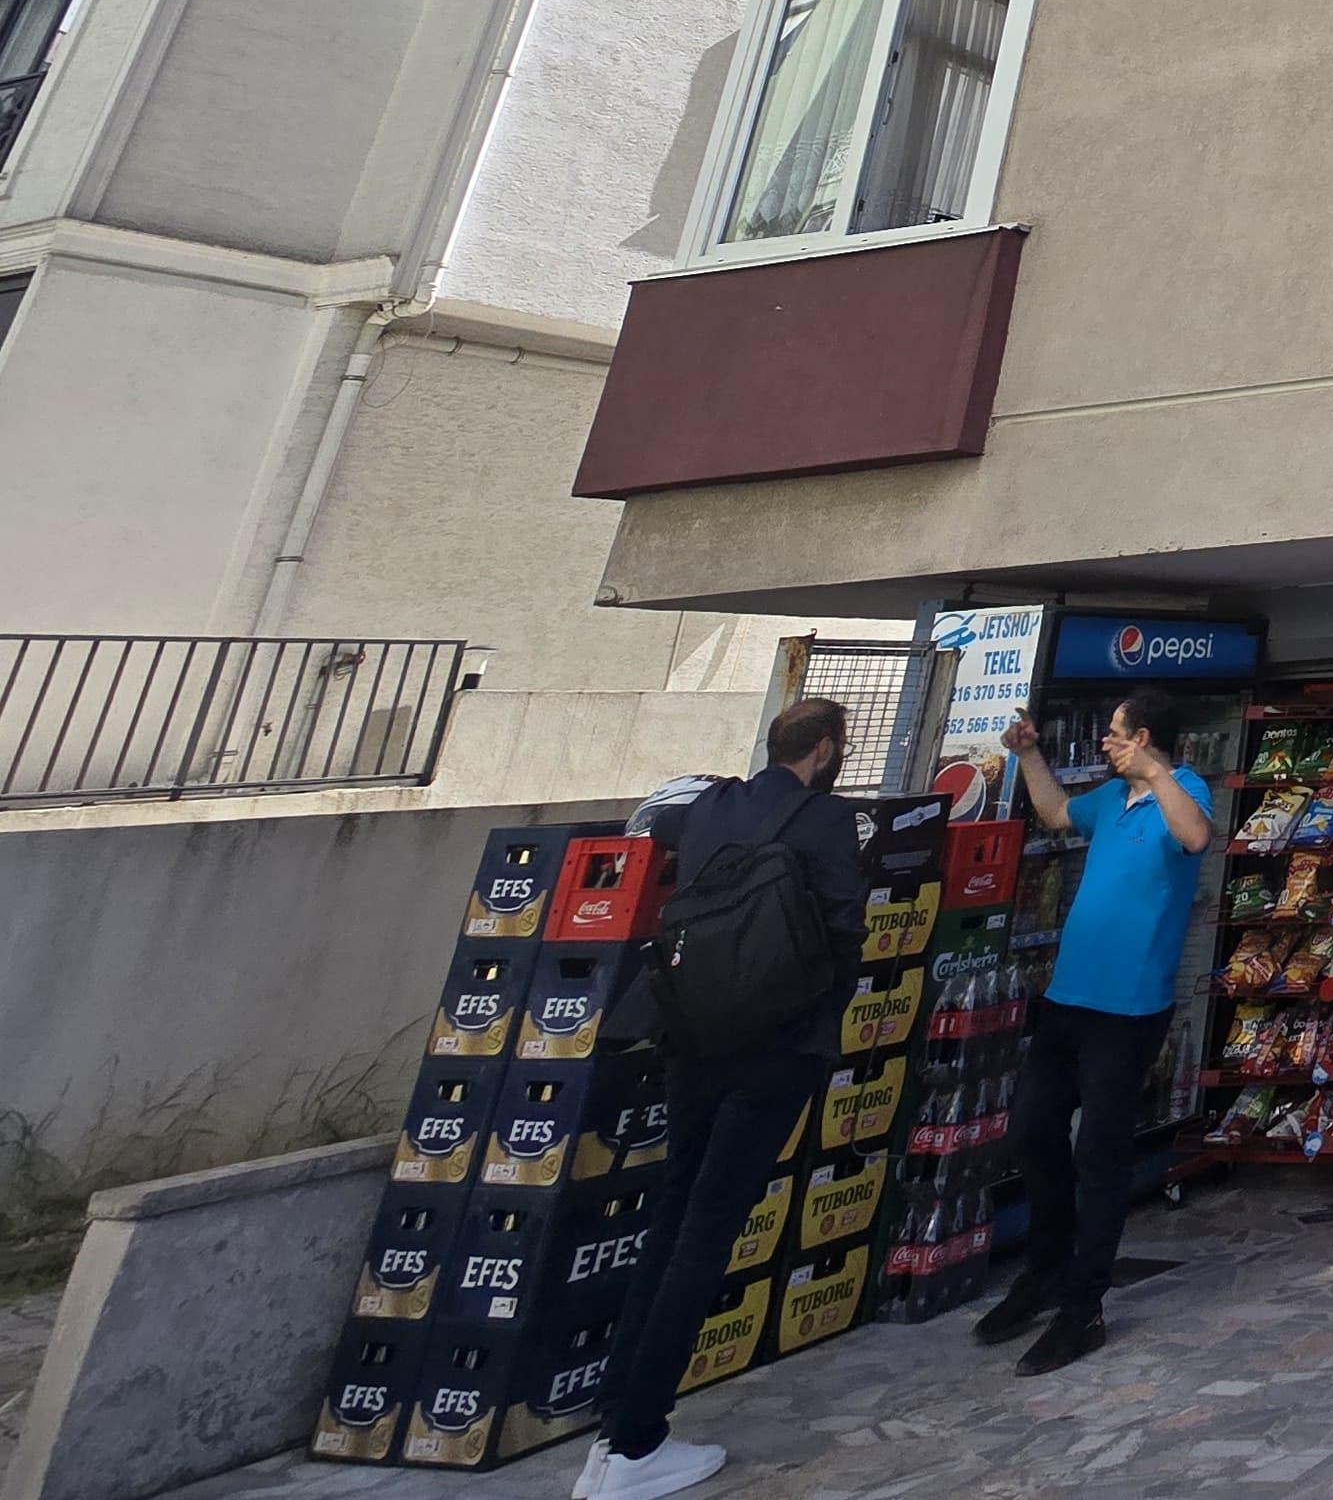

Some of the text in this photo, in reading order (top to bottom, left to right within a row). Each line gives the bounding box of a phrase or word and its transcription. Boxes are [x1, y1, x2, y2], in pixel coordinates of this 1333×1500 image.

[1147, 632, 1214, 665] pepsi
[983, 649, 1021, 676] TEKEL
[974, 685, 995, 701] 370
[999, 684, 1012, 700] 55
[1015, 682, 1028, 698] 63
[967, 717, 988, 733] 566
[991, 716, 1005, 732] 55
[490, 878, 533, 899] EFES
[869, 909, 928, 933] TUBORG
[455, 994, 500, 1016] EFES
[542, 997, 587, 1019] EFES
[850, 995, 912, 1026] TUBORG
[832, 1085, 894, 1119] TUBORG
[418, 1118, 464, 1141] EFES
[508, 1119, 555, 1143] EFES
[811, 1179, 876, 1218] TUBORG
[380, 1249, 427, 1274] EFES
[460, 1256, 523, 1291] EFES
[791, 1277, 854, 1319] TUBORG
[340, 1384, 387, 1411] EFES
[432, 1388, 480, 1415] EFES
